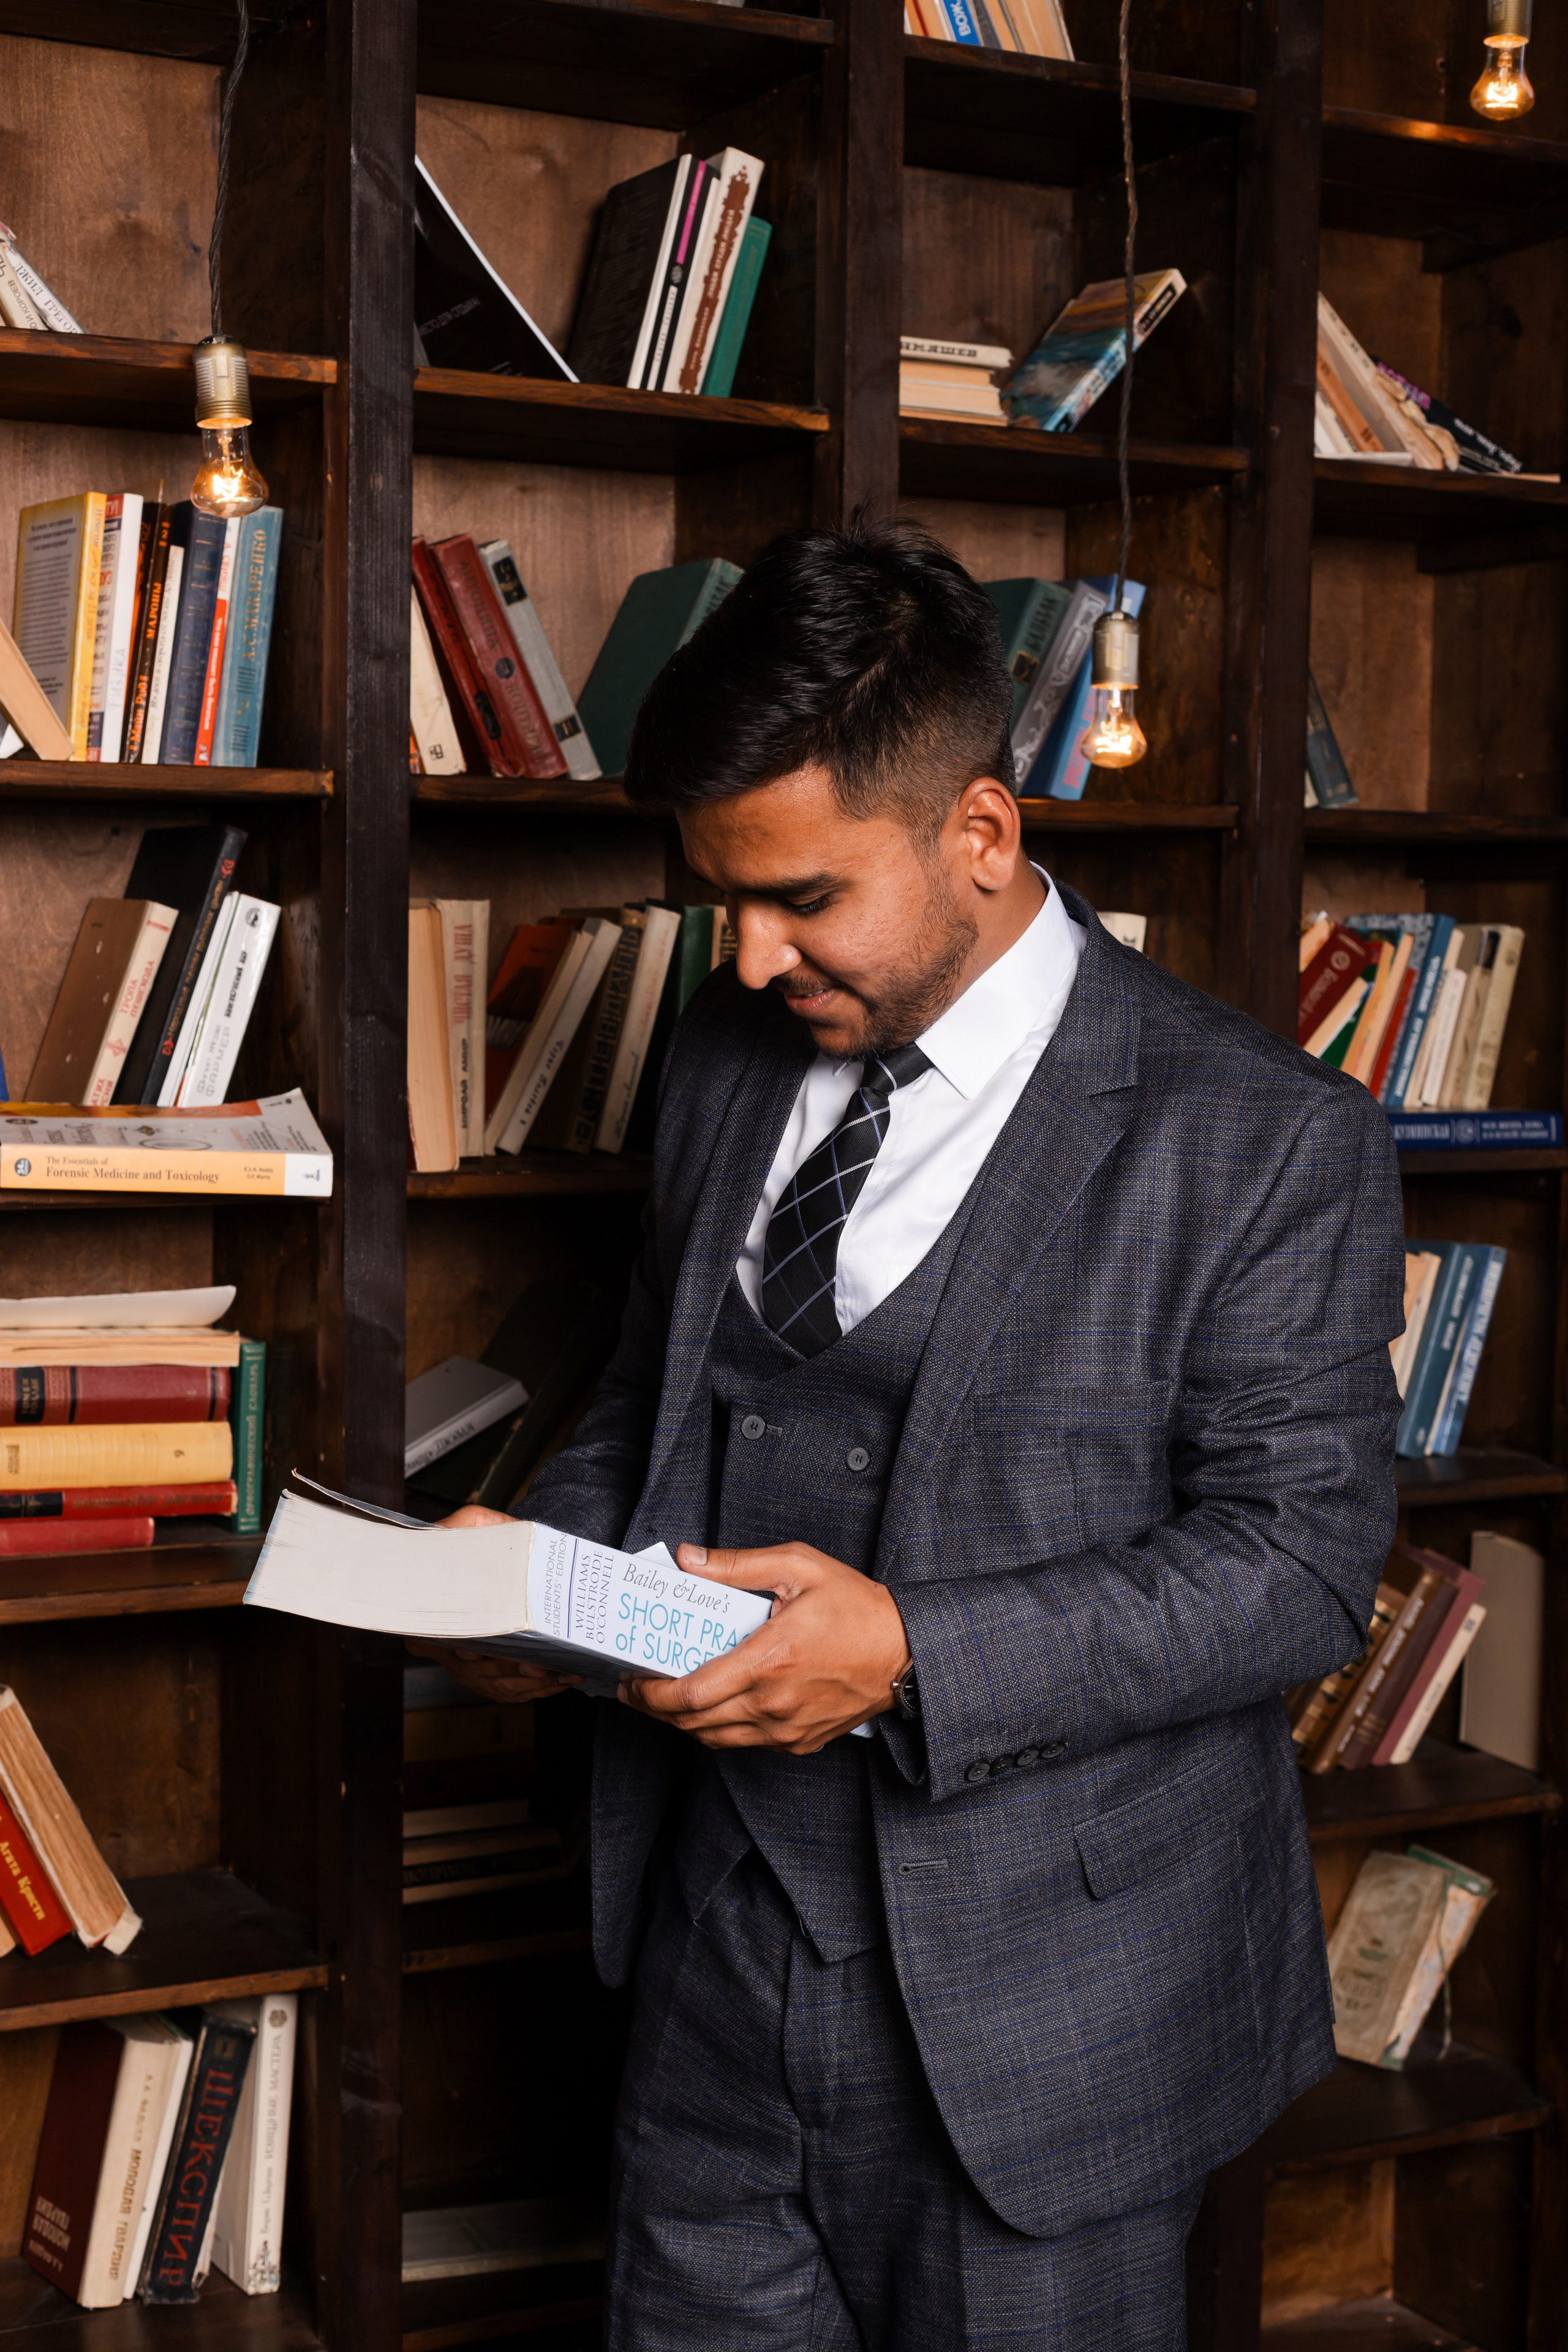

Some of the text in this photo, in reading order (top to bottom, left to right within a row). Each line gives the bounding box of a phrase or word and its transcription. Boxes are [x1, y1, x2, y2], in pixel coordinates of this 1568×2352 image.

[120, 978, 138, 1014] ТРОПА
[128, 958, 155, 1018] ПЕШЕХОДА
[454, 924, 475, 1023] ЧИСТАЯ ДУША
[46, 1167, 220, 1183] Forensic Medicine and Toxicology
[63, 1156, 99, 1165] Essentials
[249, 1363, 258, 1411] СЛОВАРЬ
[545, 1540, 558, 1624] INTERNATIONAL
[575, 1554, 591, 1629] WILLIAMS
[586, 1550, 603, 1640] BULSTRODE
[597, 1555, 614, 1644] O'CONNELL
[622, 1562, 669, 1599] Bailey
[616, 1625, 637, 1654] of
[618, 1593, 751, 1652] SHORT PRA
[0, 1841, 46, 1920] Агата Кристи
[119, 2148, 143, 2214] МОЛОДАЯ
[158, 2068, 234, 2288] ШЕКСПИР
